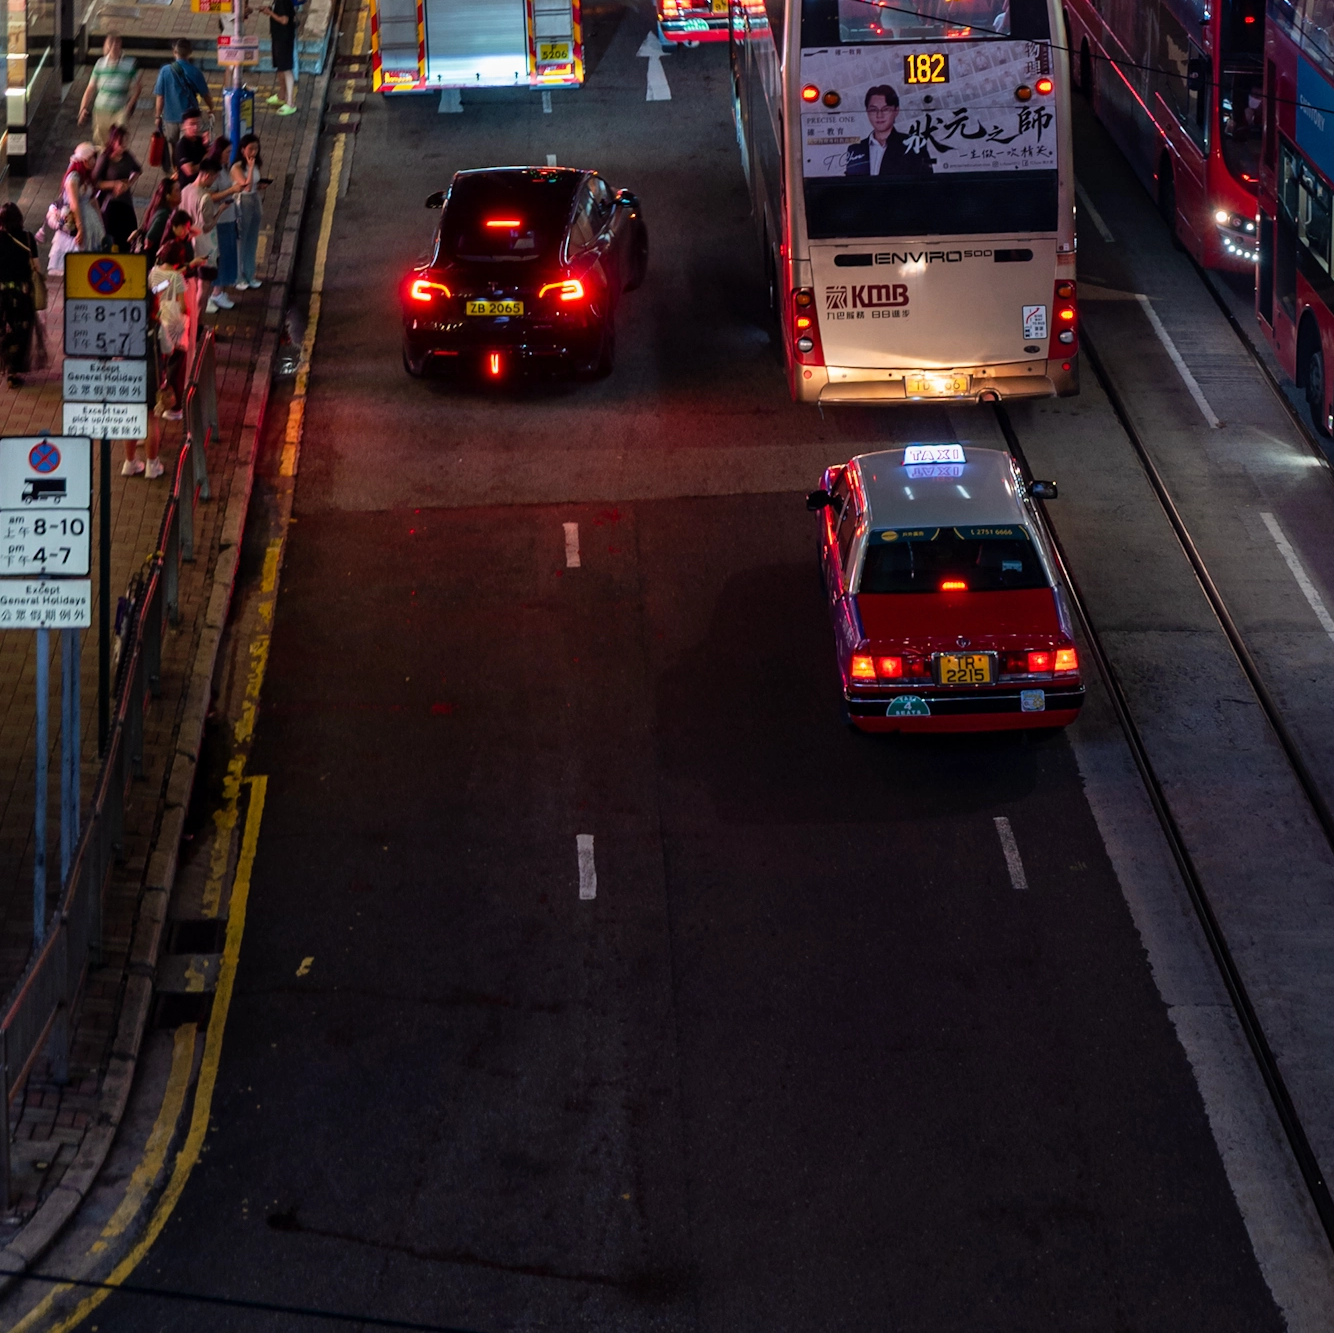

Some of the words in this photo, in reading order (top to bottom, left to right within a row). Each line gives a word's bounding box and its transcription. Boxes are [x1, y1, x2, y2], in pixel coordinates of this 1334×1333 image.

[541, 51, 568, 60] 5206
[906, 53, 946, 84] 182
[806, 116, 837, 125] PRECISE
[807, 127, 845, 136] 確一教育
[903, 105, 1053, 156] 狀元之師
[851, 283, 910, 309] KMB
[71, 311, 92, 324] 上午
[826, 311, 865, 320] 九巴服務
[871, 309, 910, 319] 日日進步
[71, 338, 92, 350] 下午
[95, 332, 131, 350] 5-7
[89, 363, 120, 374] Except
[67, 373, 102, 382] General
[104, 373, 143, 384] Holidays
[68, 383, 142, 396] 公眾假期例外
[82, 405, 111, 416] Except
[112, 405, 129, 414] taxi
[72, 415, 89, 423] pick
[91, 415, 124, 425] up/drop
[125, 415, 138, 423] off
[909, 448, 960, 462] TAXI
[9, 515, 25, 523] am
[4, 526, 30, 539] 上午
[33, 518, 85, 536] 8-10
[976, 528, 994, 536] 2751
[994, 527, 1013, 535] 6666
[8, 544, 25, 554] pm
[1, 554, 30, 568] 下午
[32, 546, 71, 565] 4-7
[25, 585, 61, 595] Except
[0, 595, 40, 605] General
[42, 595, 86, 606] Holidays
[1, 608, 85, 622] 公眾假期例外
[956, 655, 976, 670] TR
[946, 668, 985, 682] 2215
[903, 701, 912, 710] 4
